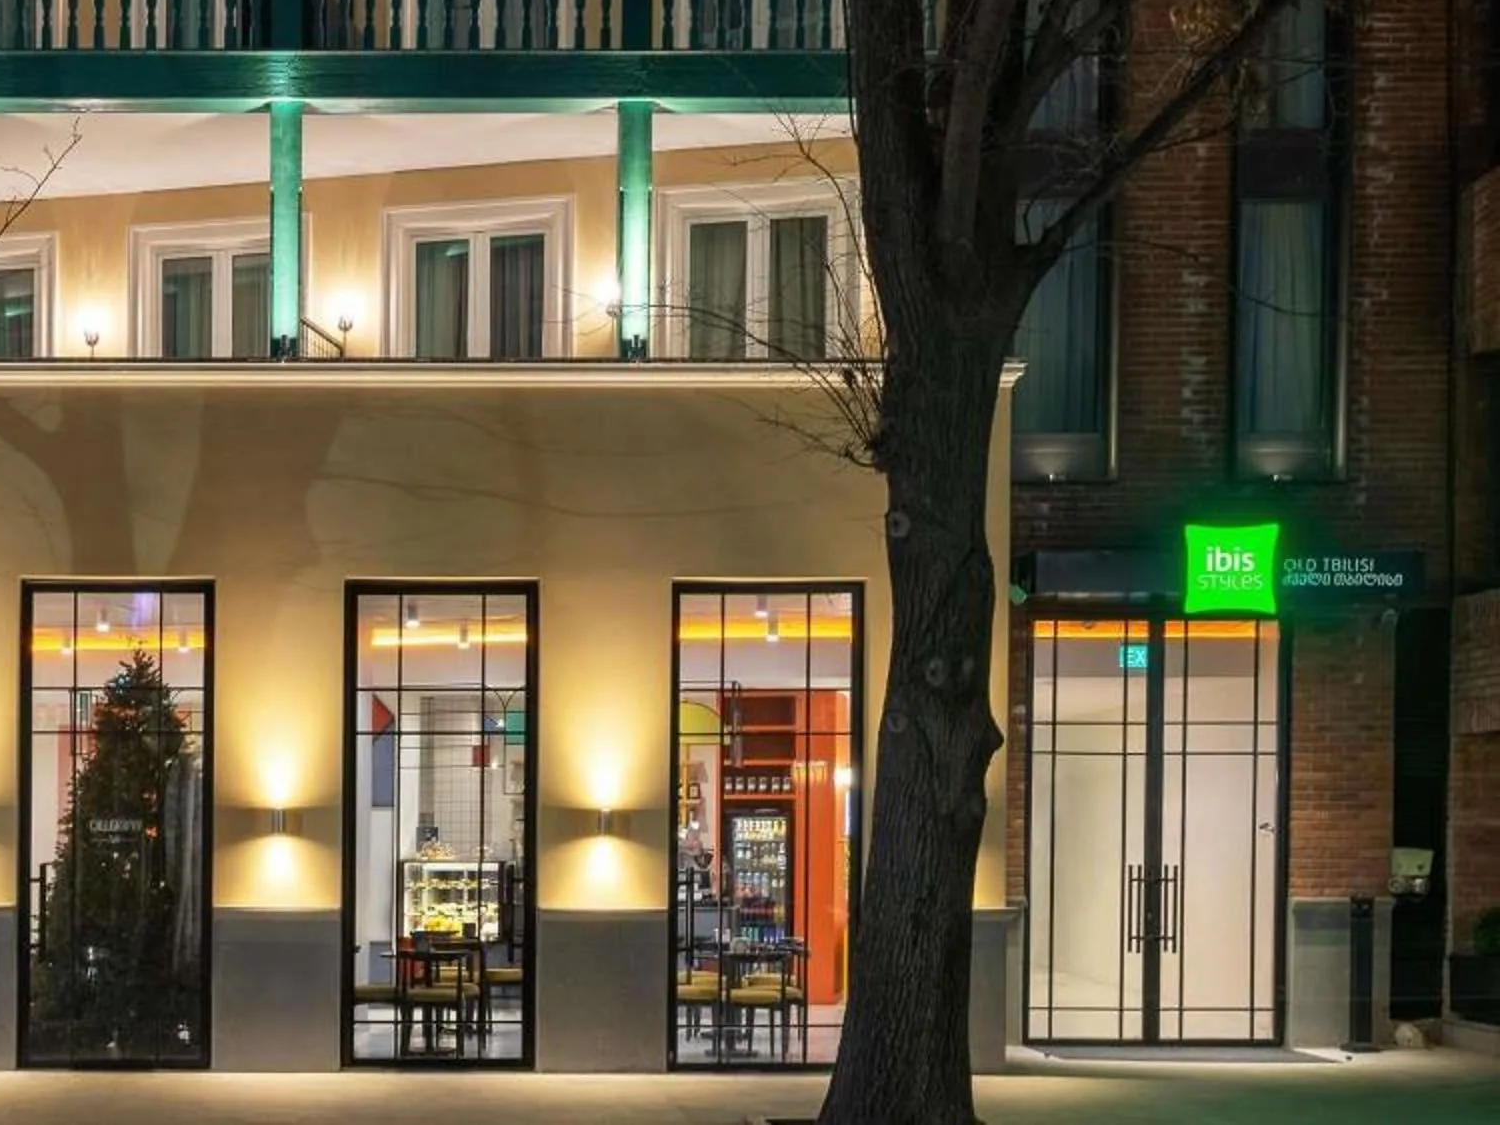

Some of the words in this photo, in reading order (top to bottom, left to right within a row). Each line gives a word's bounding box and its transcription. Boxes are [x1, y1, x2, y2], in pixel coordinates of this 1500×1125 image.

[1206, 546, 1255, 572] ibis
[1283, 558, 1317, 572] OLD
[1322, 558, 1375, 572] TBILISI
